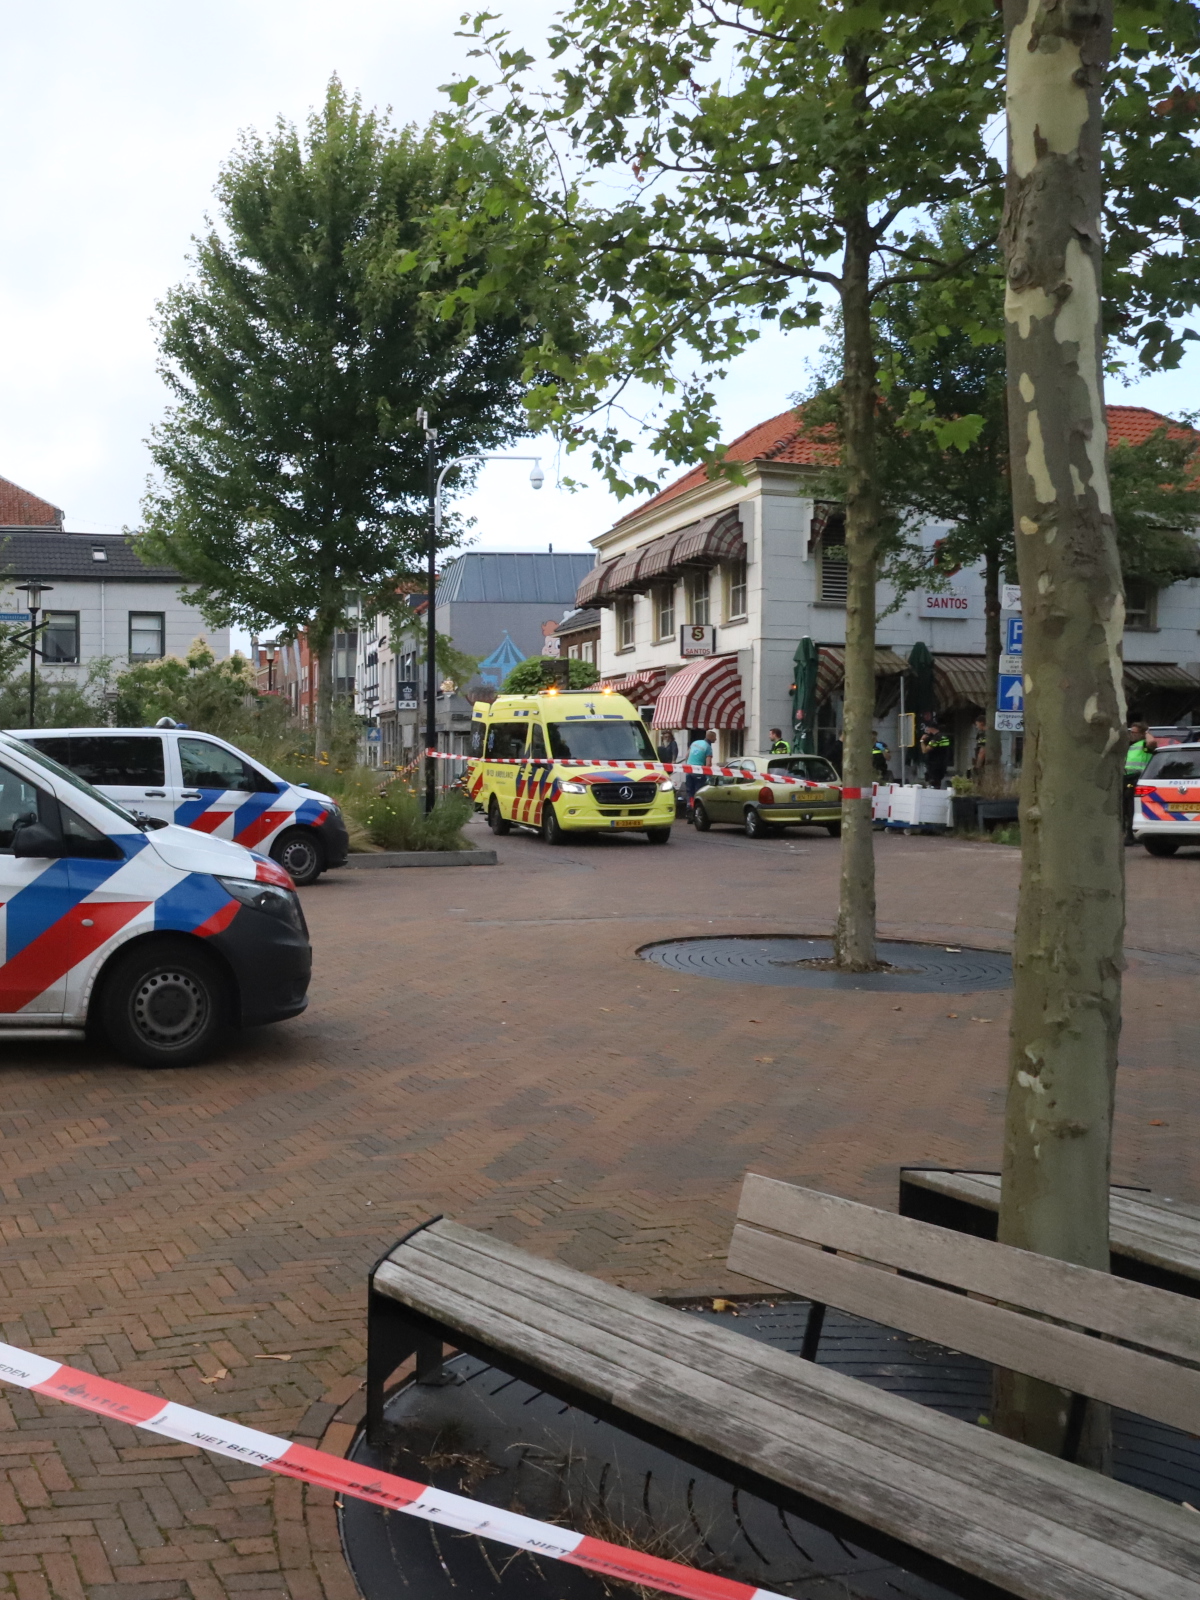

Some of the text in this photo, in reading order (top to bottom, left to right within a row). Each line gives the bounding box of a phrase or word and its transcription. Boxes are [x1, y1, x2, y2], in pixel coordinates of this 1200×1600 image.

[926, 597, 968, 609] SANTOS
[694, 629, 702, 639] S
[57, 1383, 129, 1412] POLITIE
[191, 1431, 309, 1473] NIET BETREDEN
[348, 1482, 441, 1515] POLITIE
[526, 1538, 681, 1588] NIET BETREDEN
